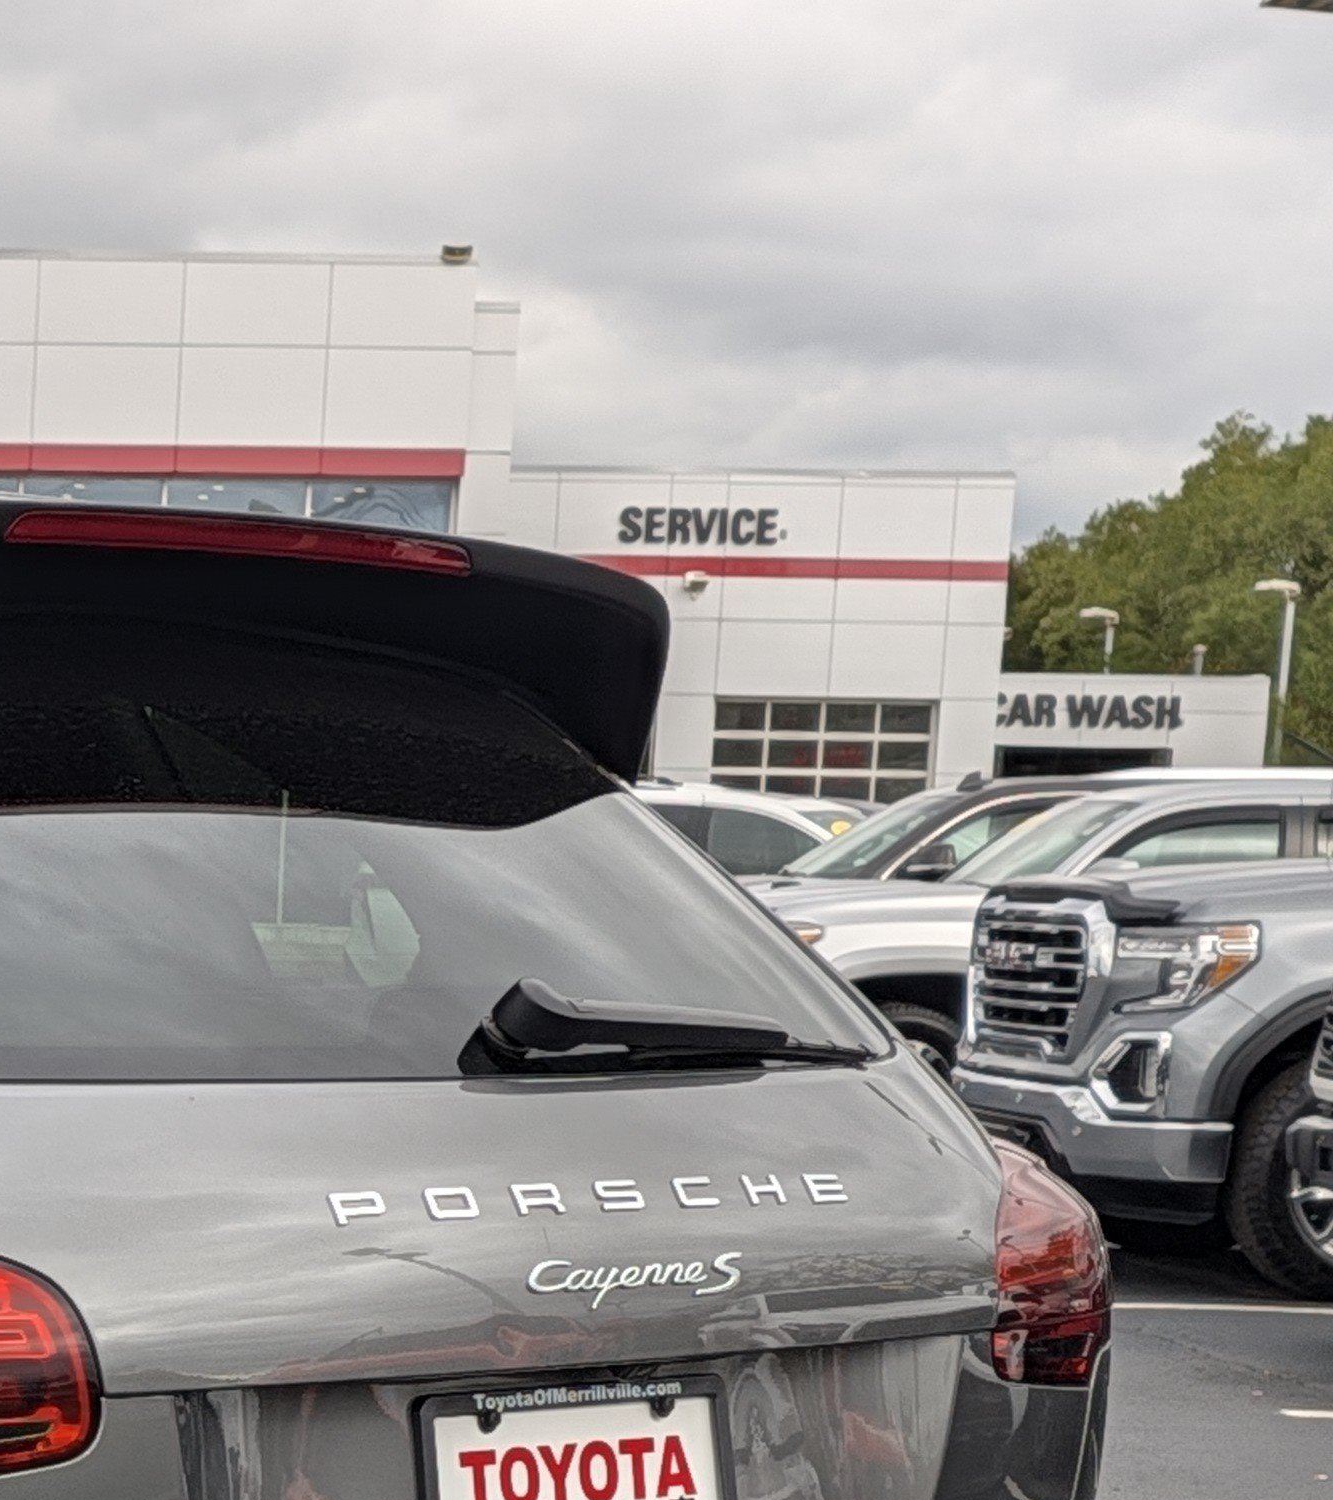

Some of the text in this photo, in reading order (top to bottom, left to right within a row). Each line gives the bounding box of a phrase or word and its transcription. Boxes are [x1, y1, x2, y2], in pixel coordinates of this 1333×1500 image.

[618, 506, 779, 546] SERVICE
[1066, 694, 1181, 729] WASH
[327, 1173, 849, 1227] PORSCHE
[526, 1251, 743, 1310] Cayenne S
[473, 1380, 683, 1414] ToyotaOfMerrillville.com
